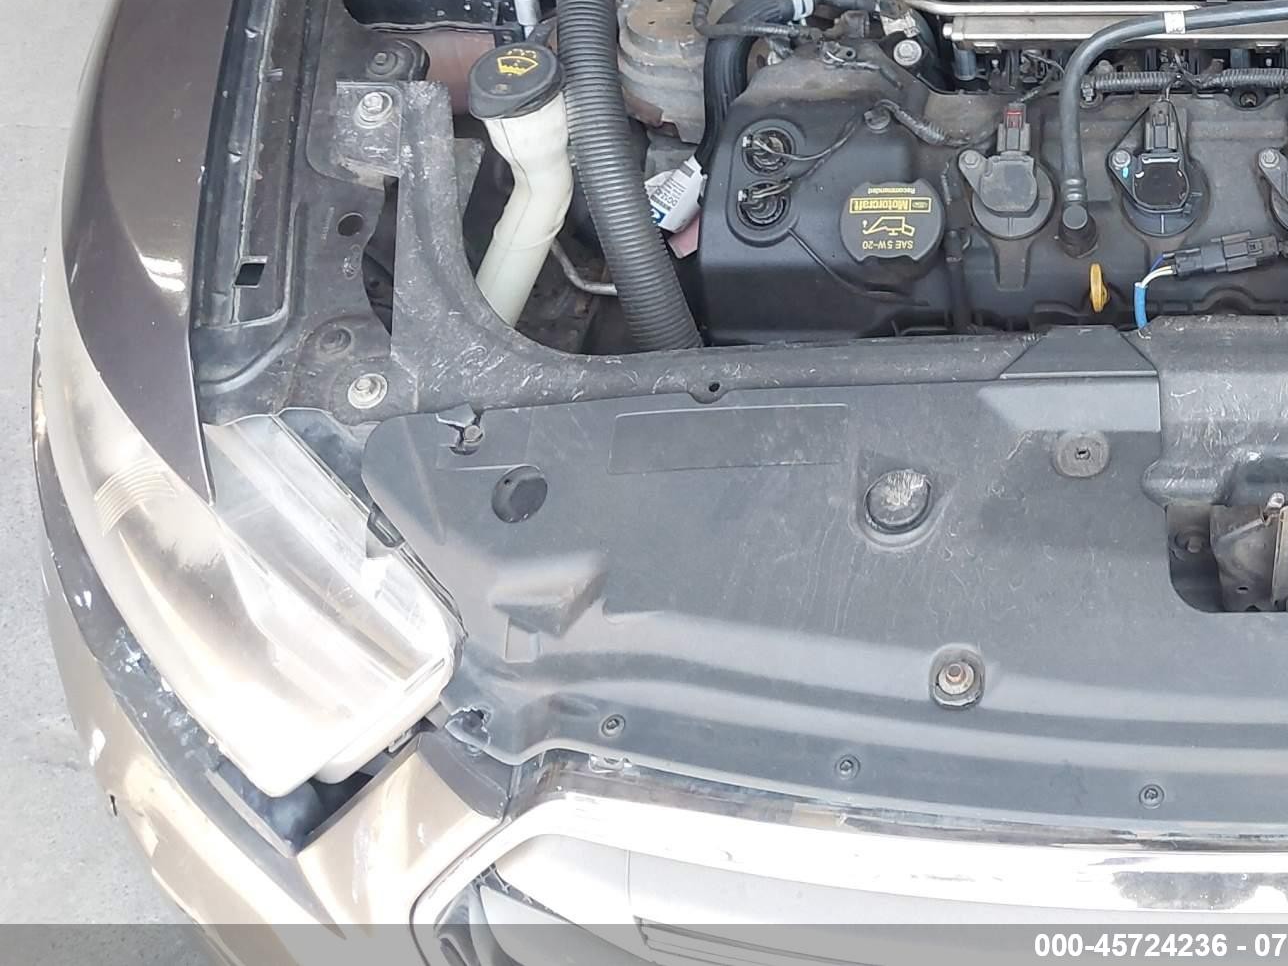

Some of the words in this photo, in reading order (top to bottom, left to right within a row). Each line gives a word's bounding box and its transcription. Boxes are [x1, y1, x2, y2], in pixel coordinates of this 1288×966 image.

[868, 187, 915, 195] Recommended
[853, 199, 909, 211] Motorcraft
[862, 240, 894, 250] 5W-20
[895, 240, 914, 250] SAE
